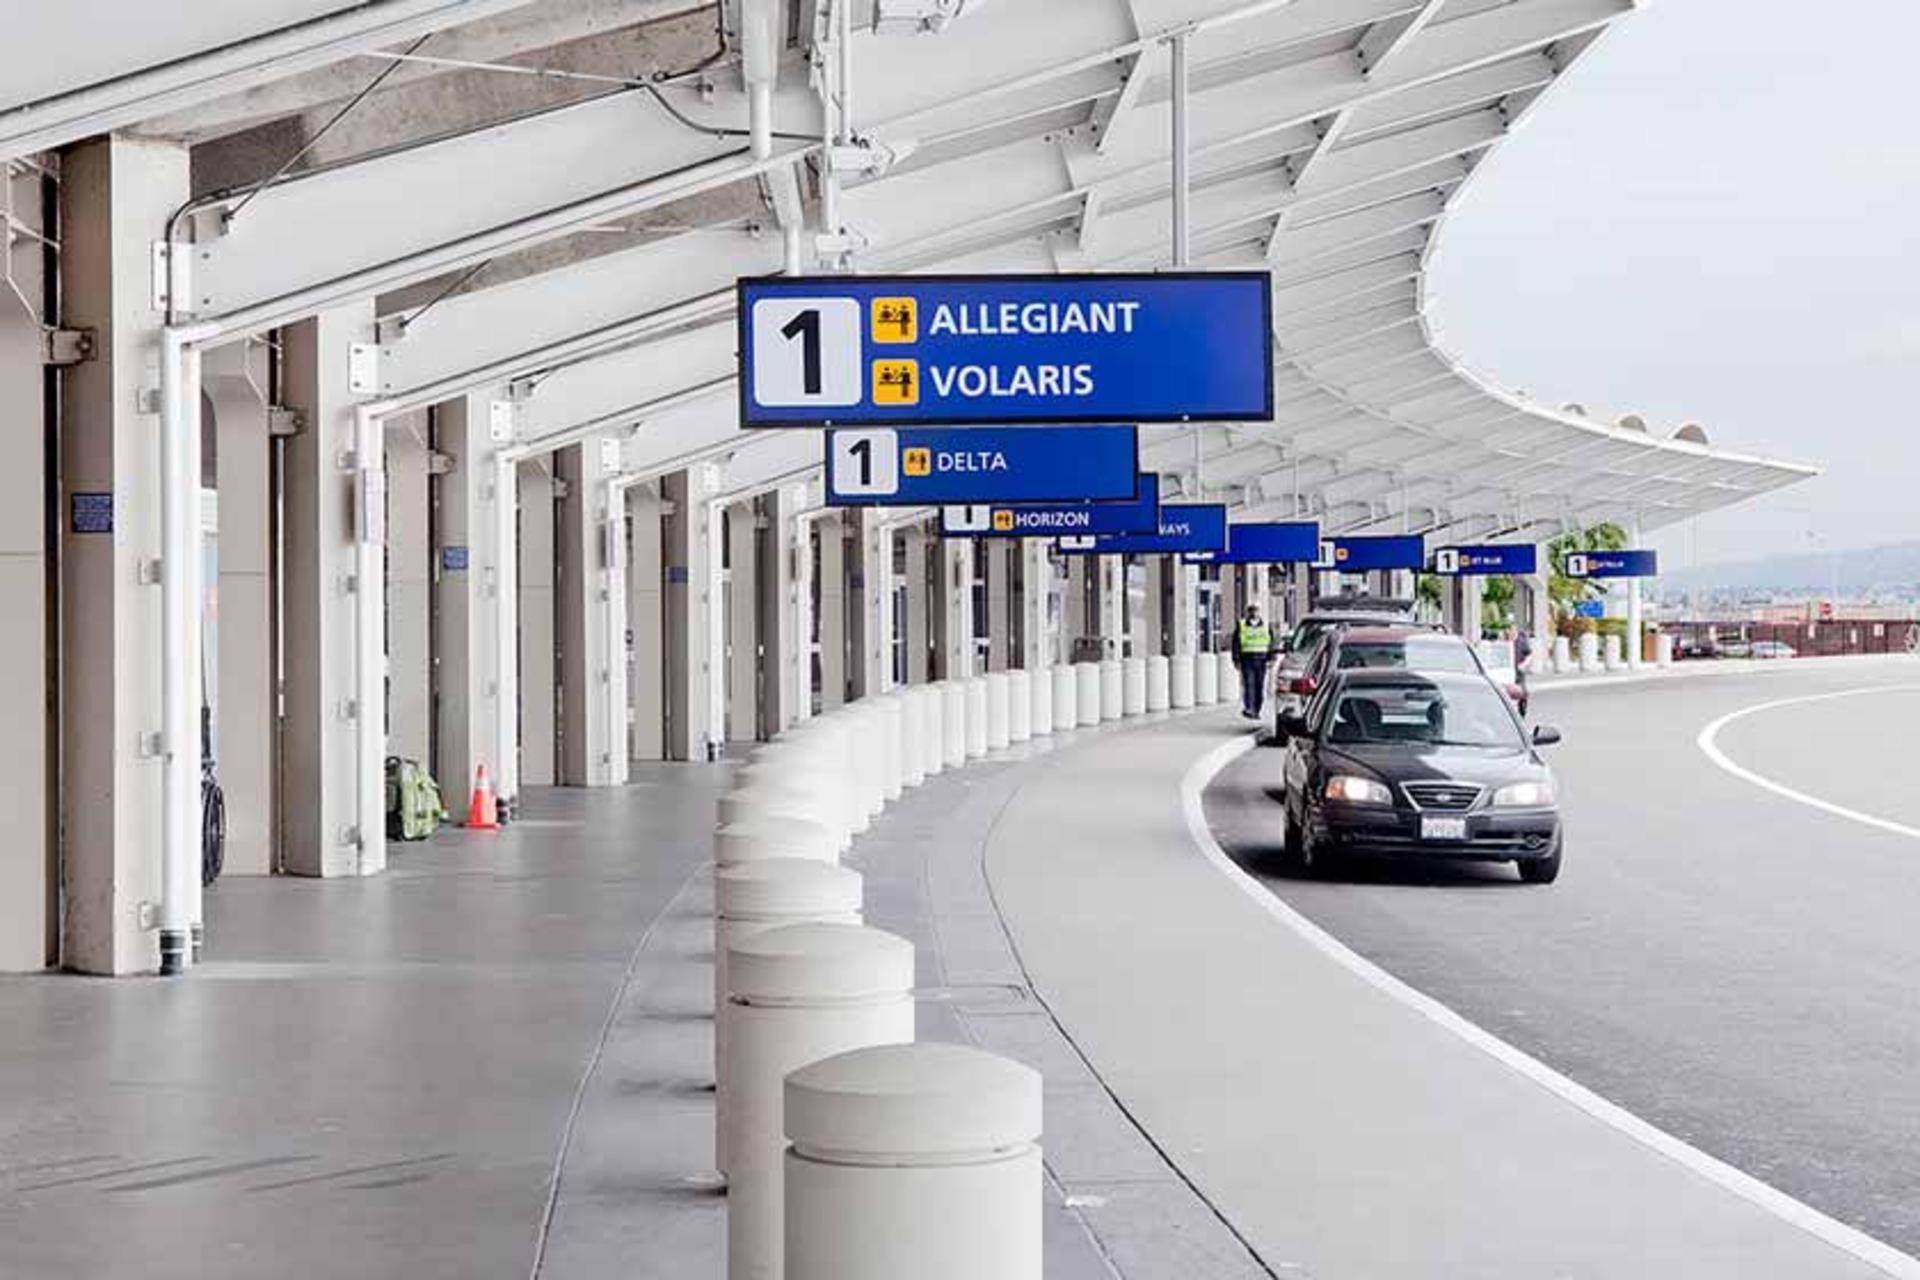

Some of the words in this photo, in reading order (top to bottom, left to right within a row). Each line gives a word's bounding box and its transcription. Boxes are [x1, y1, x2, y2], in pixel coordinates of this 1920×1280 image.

[929, 302, 1140, 335] ALLEGIANT
[780, 309, 822, 395] 1
[930, 364, 1094, 397] VOLARIS
[848, 438, 871, 486] 1
[937, 451, 1007, 472] DELTA
[1016, 511, 1089, 527] HORIZON
[1442, 553, 1451, 569] 1
[1573, 558, 1581, 572] 1
